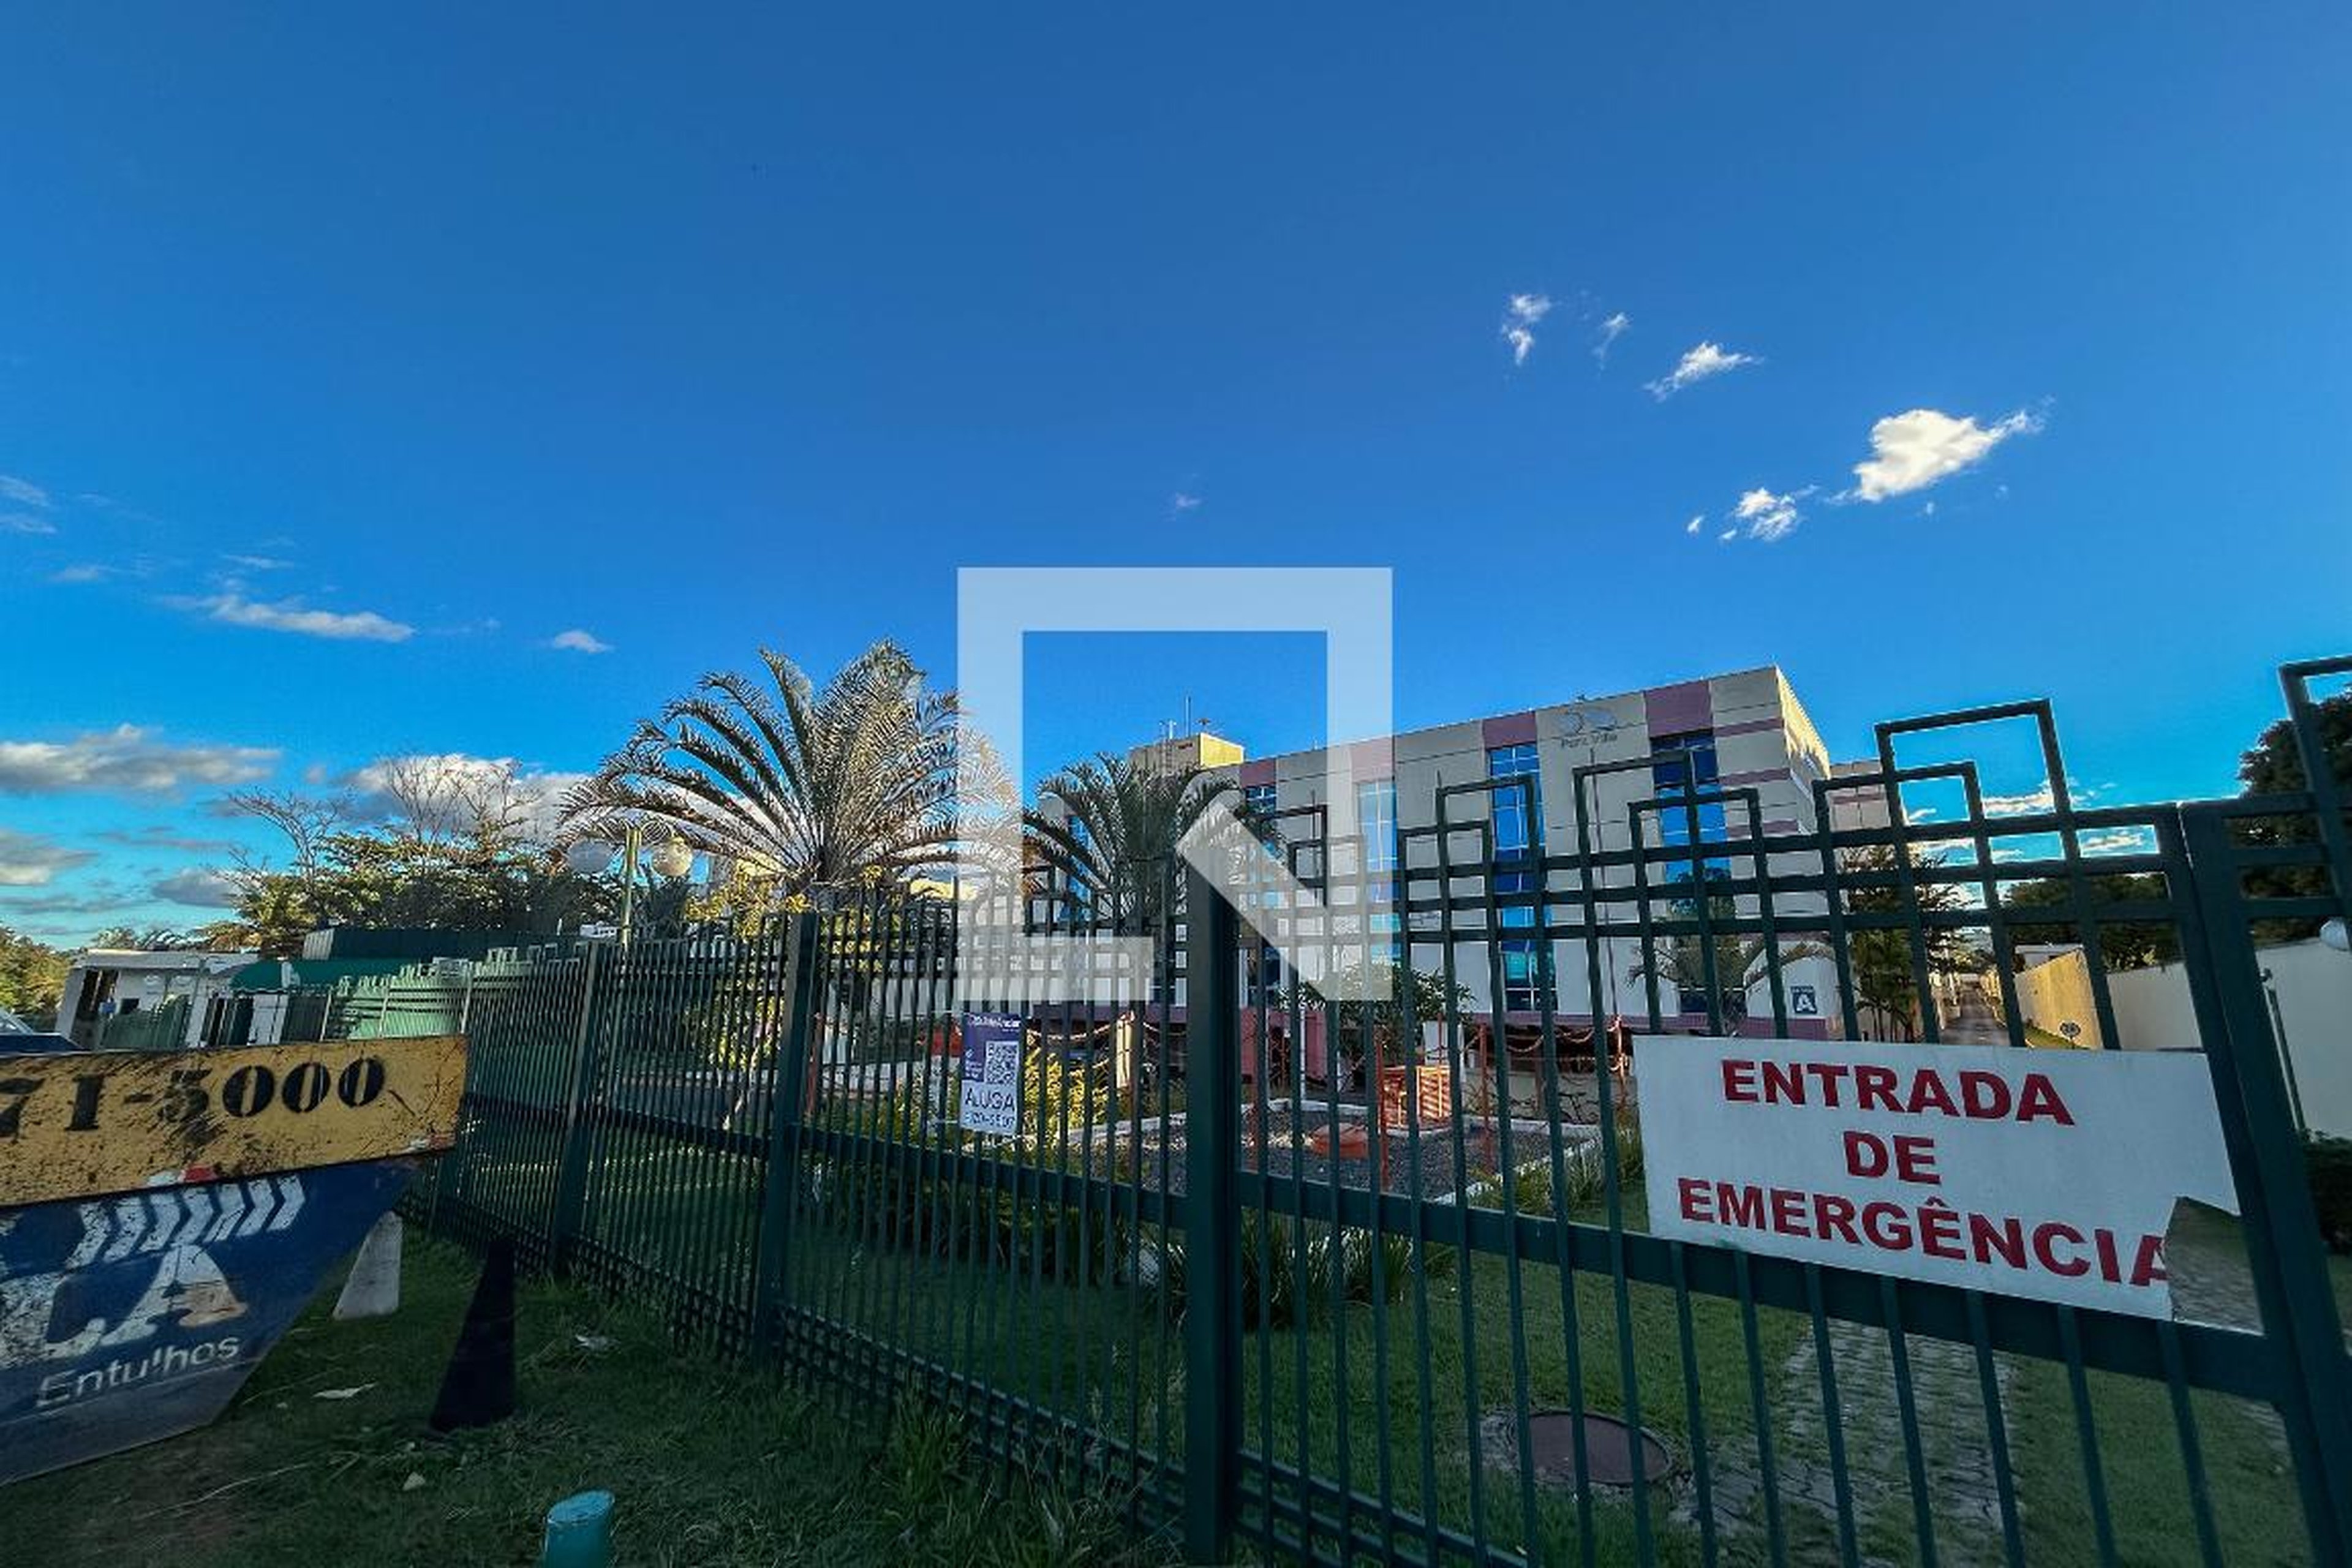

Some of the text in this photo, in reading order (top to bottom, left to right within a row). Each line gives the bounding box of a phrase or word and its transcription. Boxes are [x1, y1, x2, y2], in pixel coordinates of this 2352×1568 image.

[1721, 1058, 2075, 1126] ENTRADA
[1842, 1131, 1942, 1185] DE
[35, 1336, 241, 1409] Entulhos
